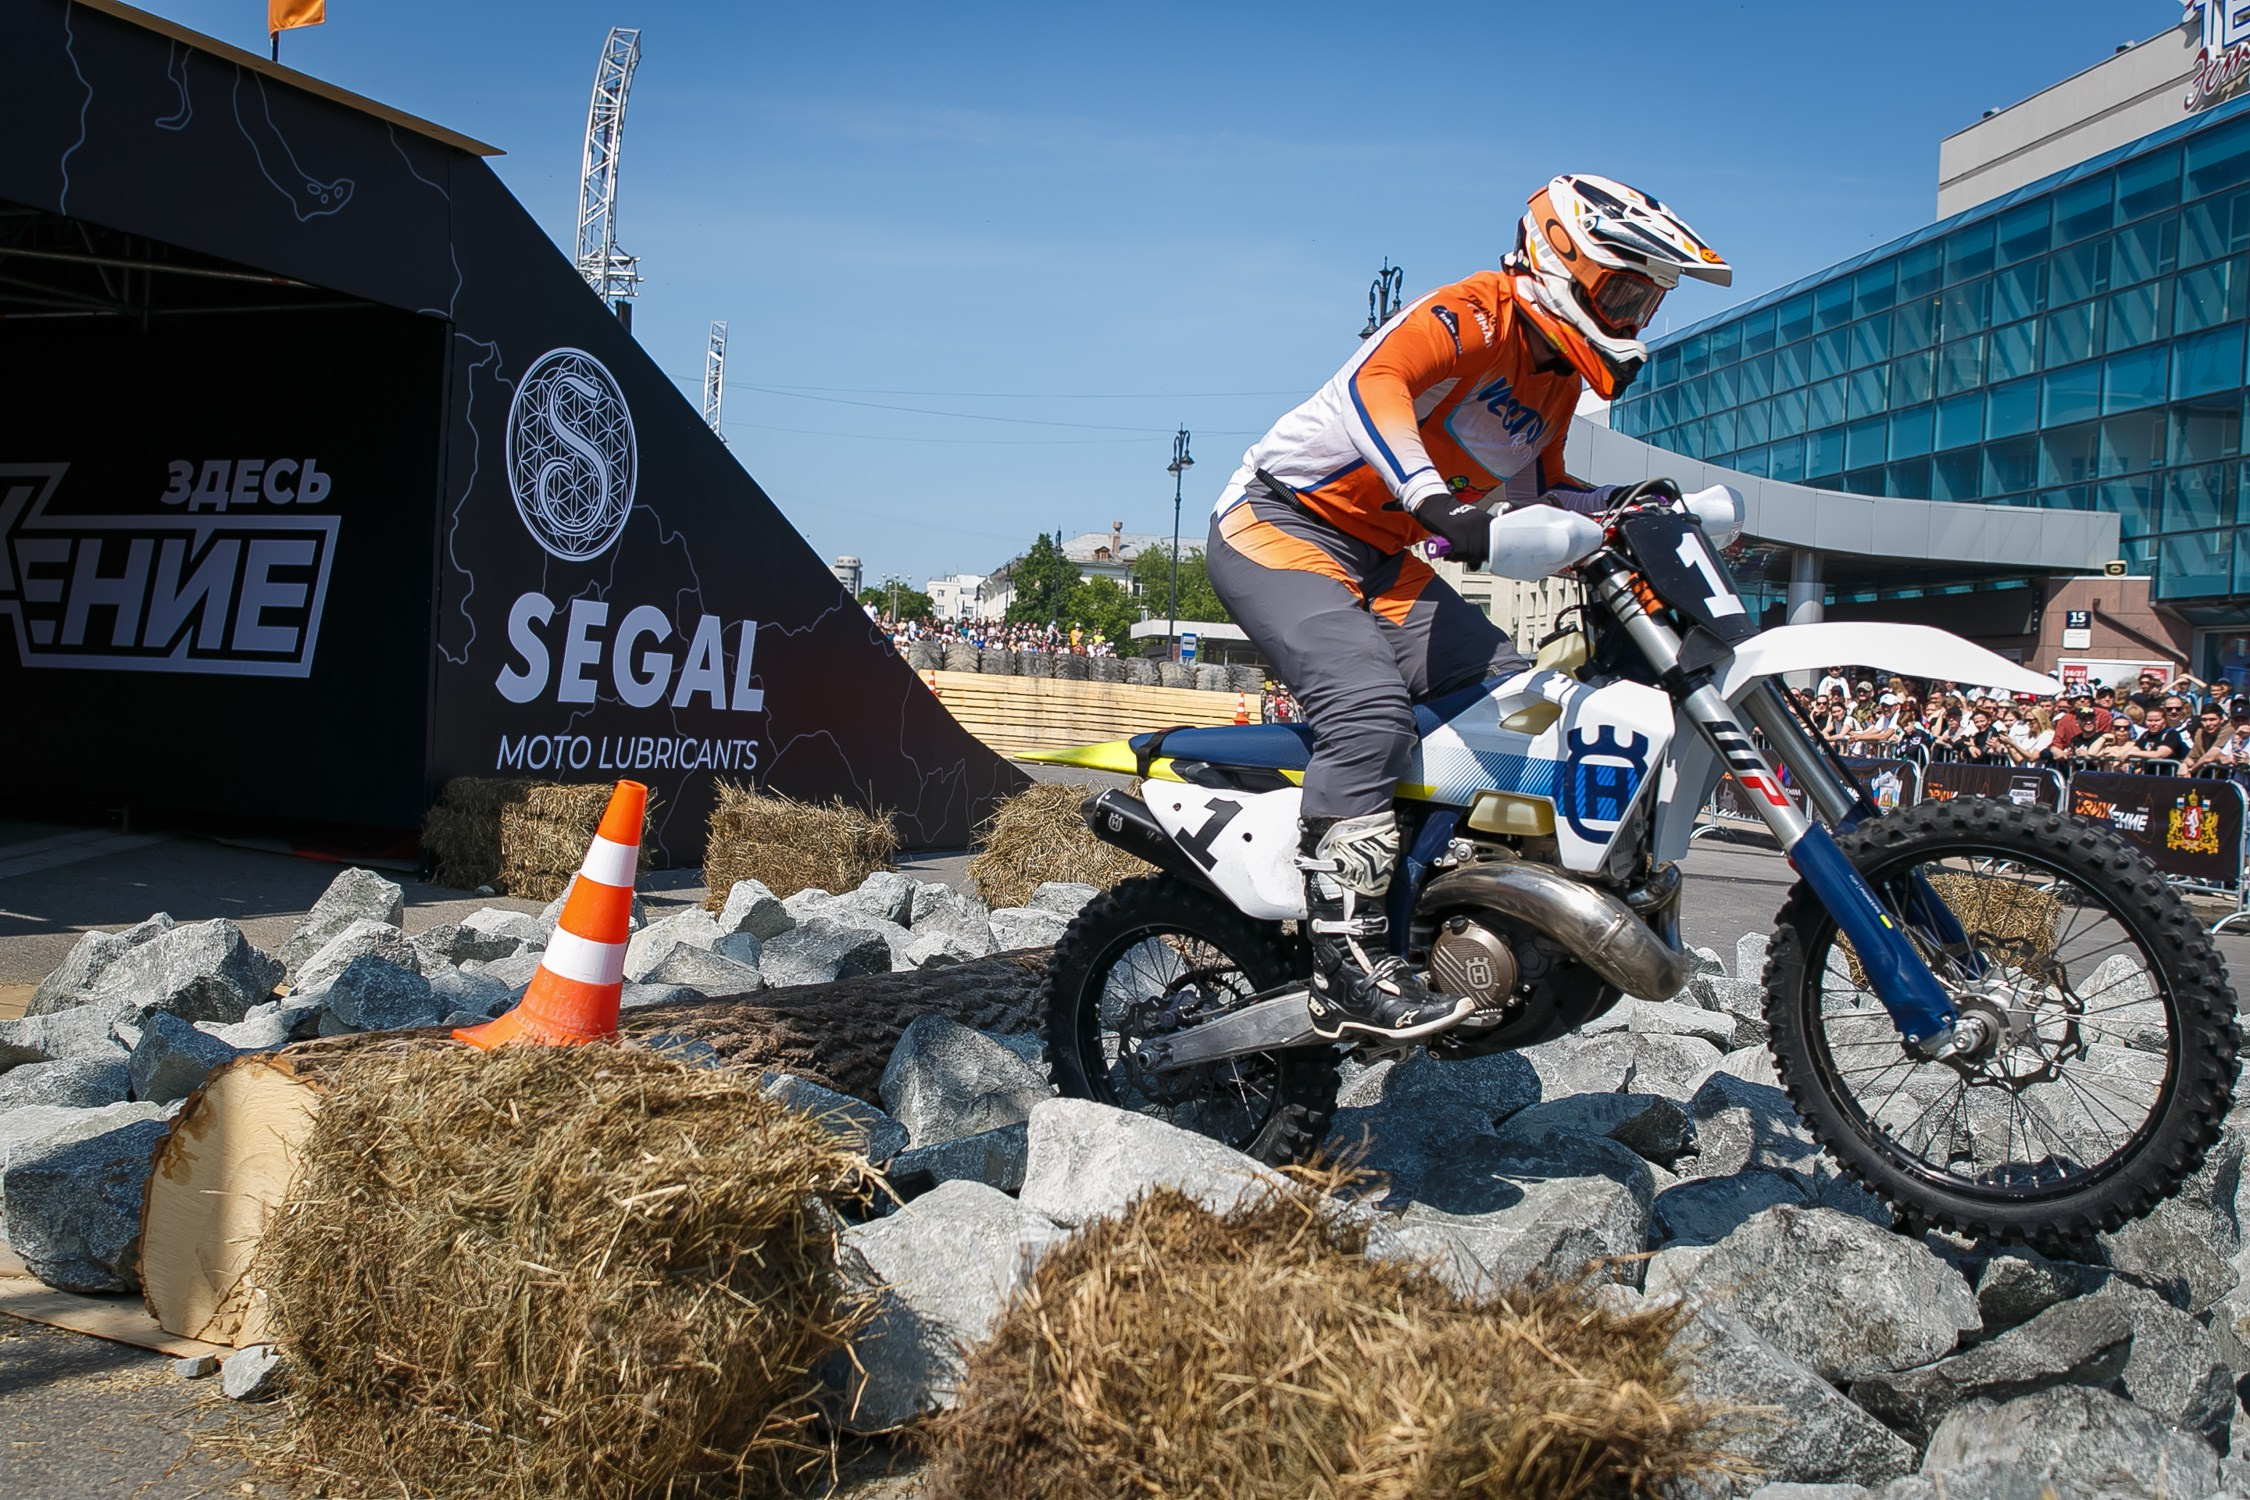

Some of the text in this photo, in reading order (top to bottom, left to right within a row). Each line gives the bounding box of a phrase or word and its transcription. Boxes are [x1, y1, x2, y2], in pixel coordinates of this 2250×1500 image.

[160, 458, 331, 512] ЗДЕСЬ
[1675, 532, 1746, 618] 1
[2070, 611, 2086, 623] 15
[495, 591, 765, 713] SEGAL
[496, 735, 759, 770] MOTO LUBRICANTS
[1174, 797, 1243, 872] 1
